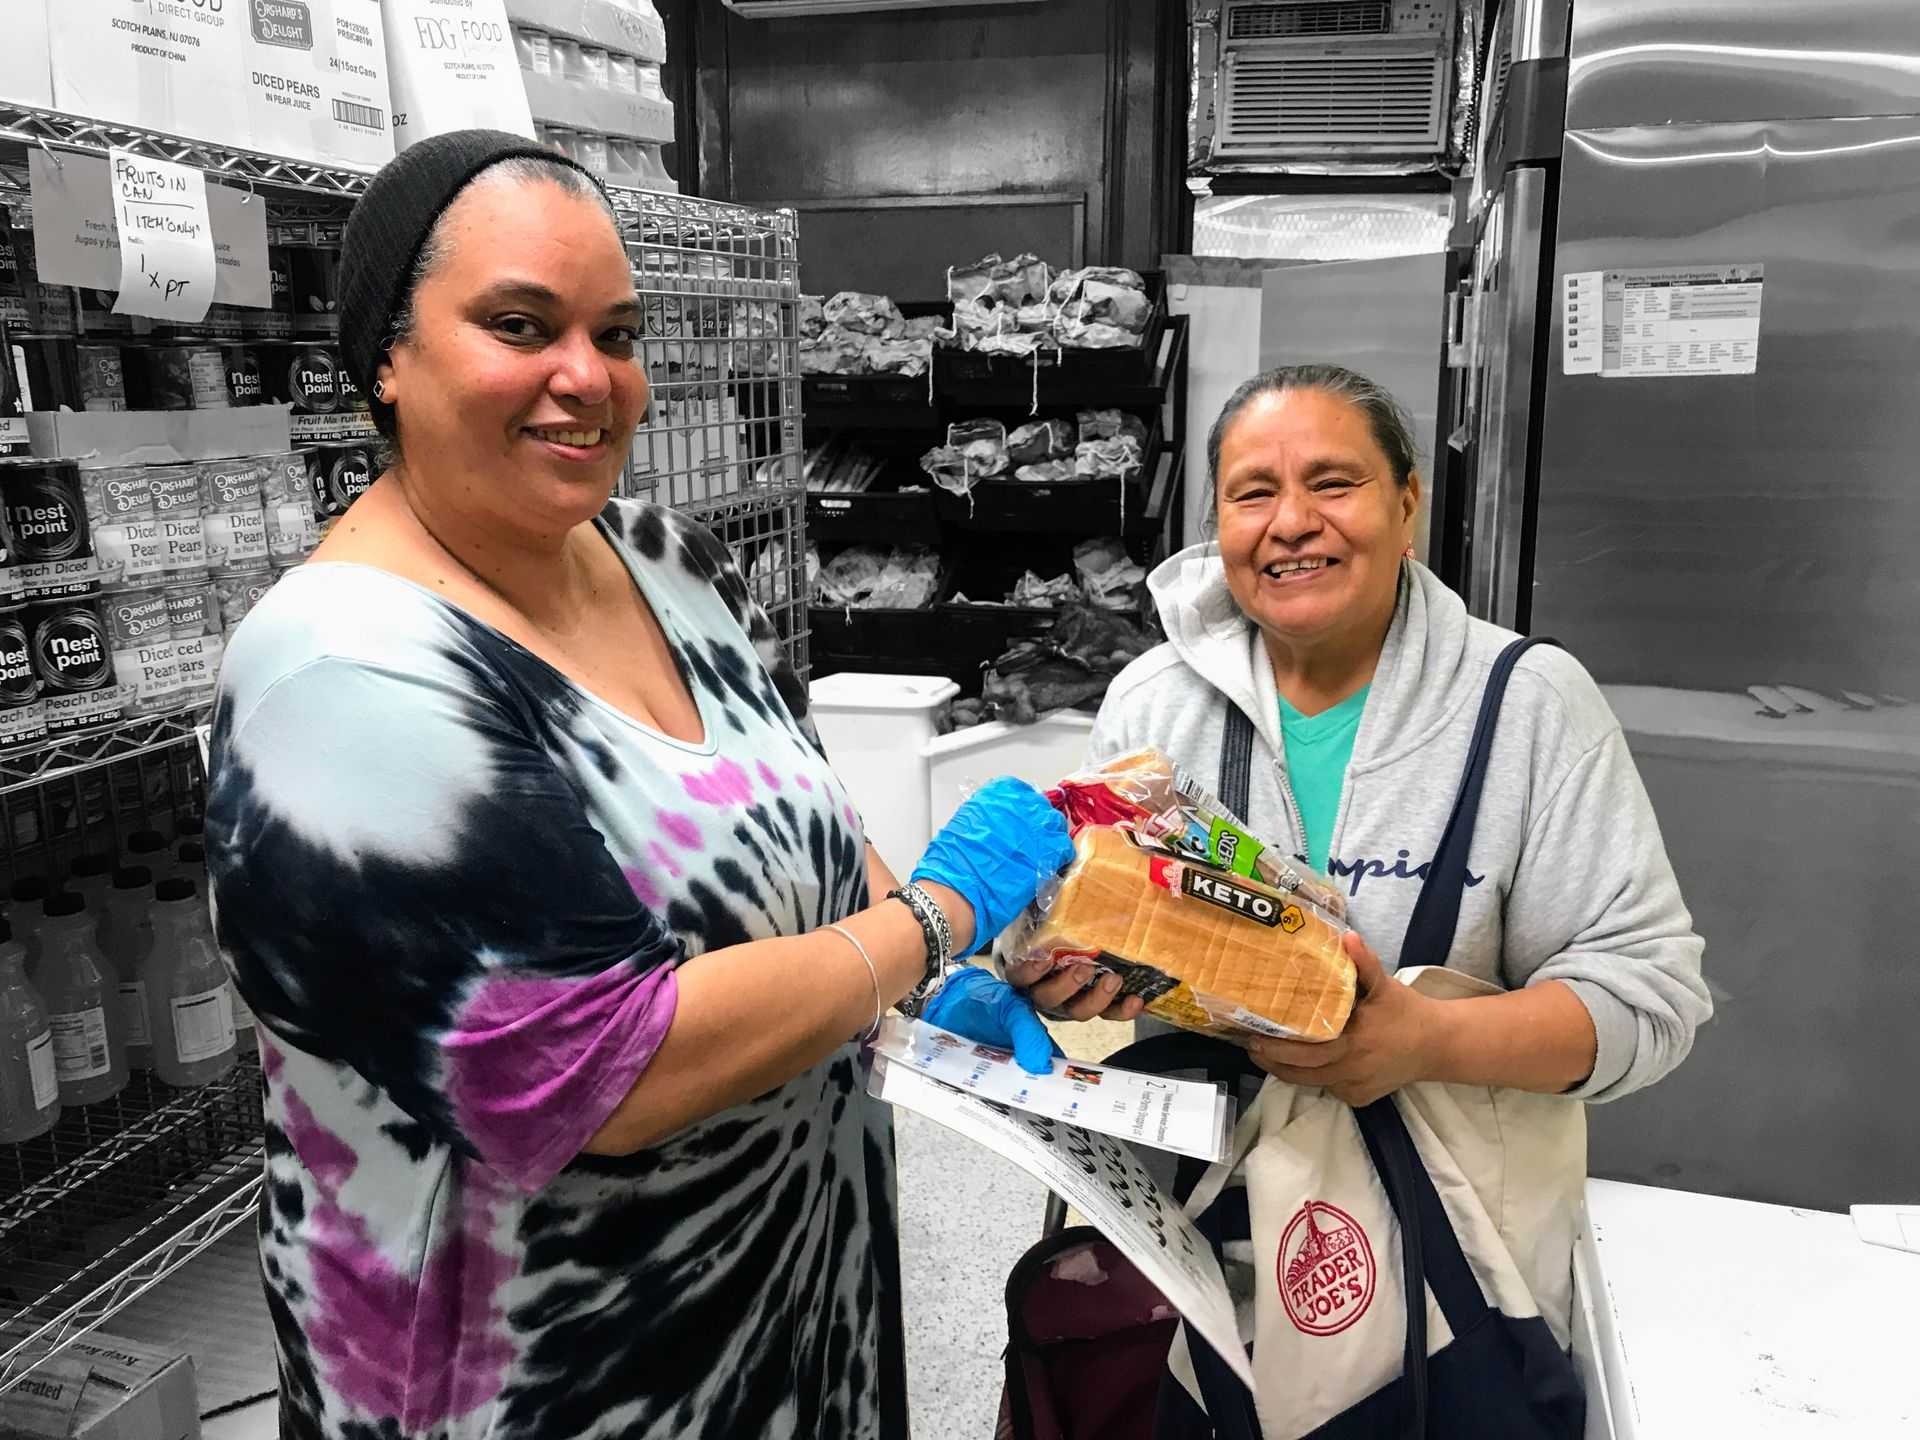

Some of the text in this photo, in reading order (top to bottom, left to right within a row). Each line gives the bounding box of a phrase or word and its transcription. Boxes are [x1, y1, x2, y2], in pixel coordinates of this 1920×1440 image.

[158, 2, 192, 19] DIRECT
[194, 11, 224, 28] GROUP
[112, 18, 141, 34] SCOTCH
[169, 31, 178, 42] NJ
[180, 34, 201, 47] 07076
[461, 20, 502, 42] FOOD
[131, 43, 187, 62] PRODUCT OF CHINA
[359, 65, 377, 79] Cans
[252, 71, 320, 99] DICED PEARS
[265, 92, 312, 111] IN PEAR JUICE
[116, 158, 186, 191] FRUITS IN
[122, 183, 153, 201] CAN
[75, 233, 100, 248] Jugos
[100, 237, 106, 248] y
[165, 279, 190, 301] PT
[301, 370, 334, 384] nest
[304, 382, 334, 396] point
[298, 416, 322, 426] Fruit
[341, 415, 357, 423] ruit
[15, 503, 68, 522] nest
[20, 519, 69, 540] point
[234, 529, 264, 545] Pears
[168, 540, 202, 554] Pears
[55, 561, 88, 575] Diced
[41, 587, 50, 595] 15
[50, 633, 100, 655] nest
[178, 641, 203, 656] ced
[56, 649, 101, 672] point
[45, 695, 87, 710] Peach
[78, 716, 88, 724] 15
[17, 733, 26, 741] 15
[1192, 874, 1273, 918] KETO
[1146, 1081, 1167, 1089] 2
[1291, 1247, 1364, 1308] TRADER
[1304, 1273, 1363, 1323] JOE'S
